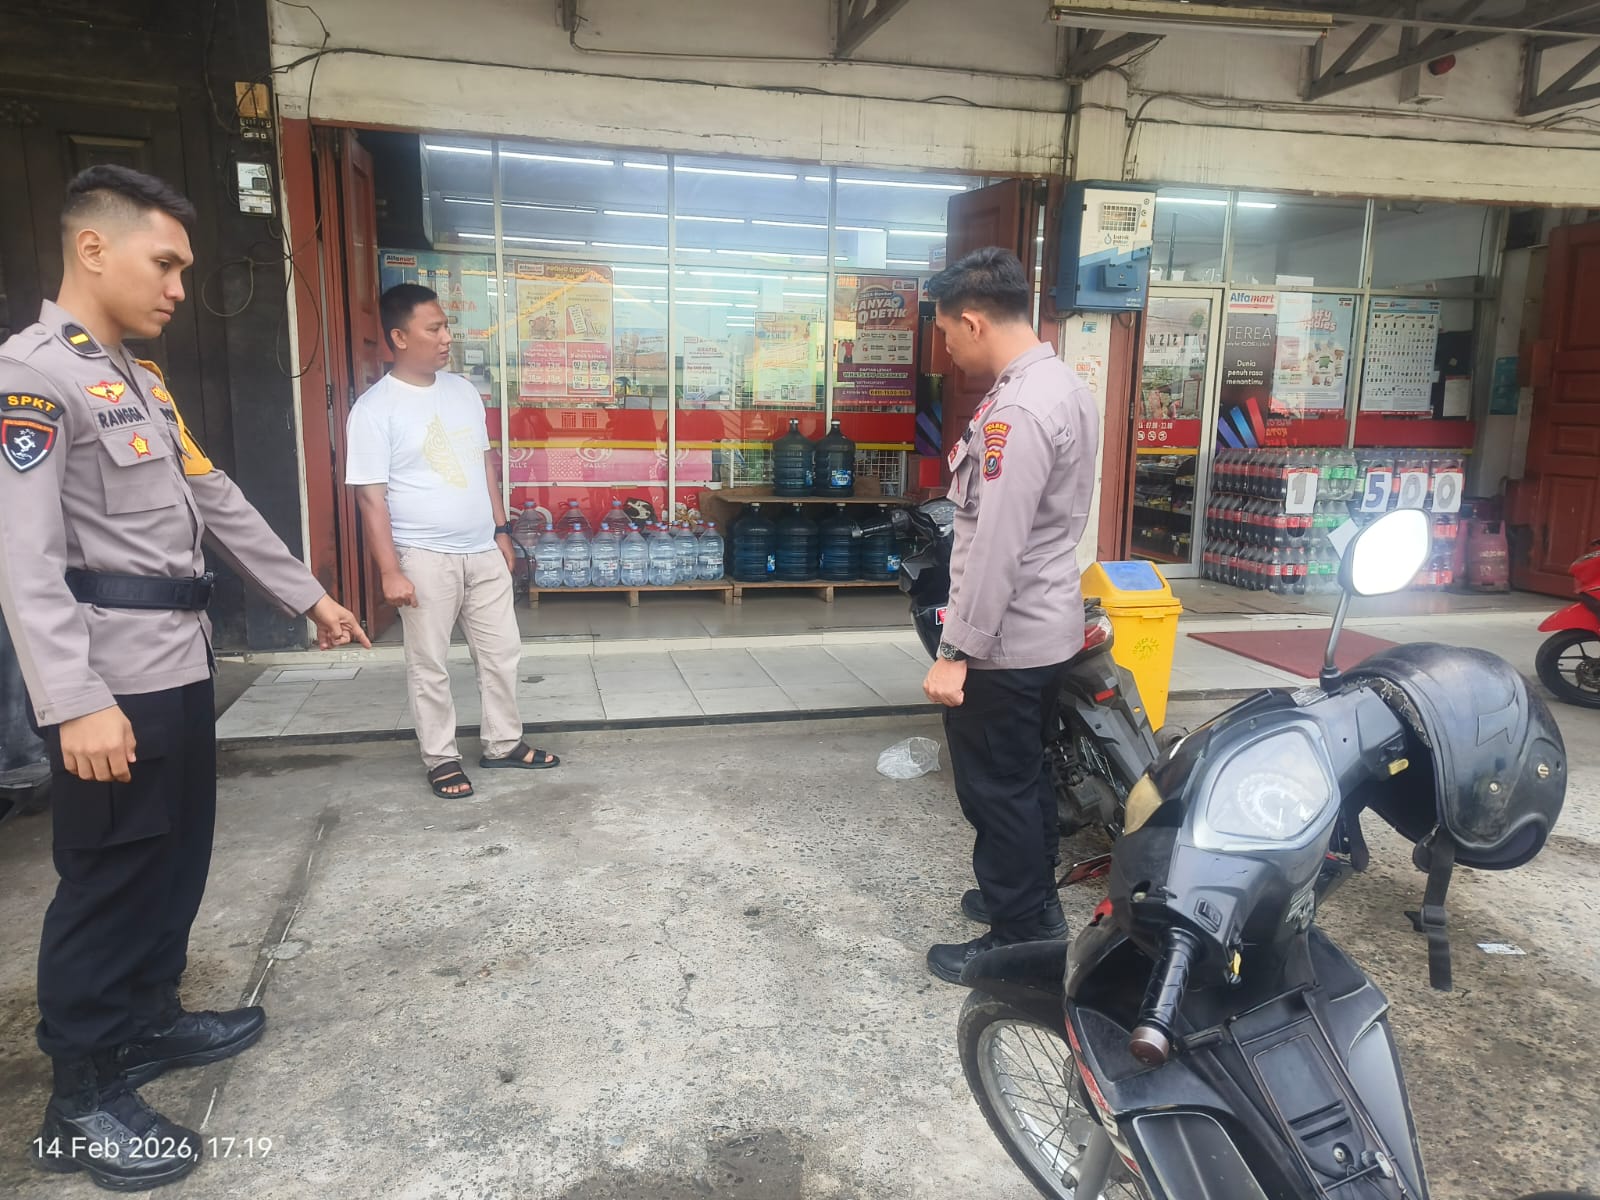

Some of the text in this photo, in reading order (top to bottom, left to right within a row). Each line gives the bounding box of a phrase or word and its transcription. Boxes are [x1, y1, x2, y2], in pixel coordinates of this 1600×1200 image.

[1230, 292, 1275, 303] Alfamart
[869, 308, 908, 319] DETIK
[1227, 326, 1272, 340] TEREA
[1236, 359, 1256, 367] Dunia
[1227, 369, 1248, 377] penuh
[7, 395, 56, 412] SPKT
[98, 406, 146, 429] RANGGA
[1292, 473, 1307, 505] 1
